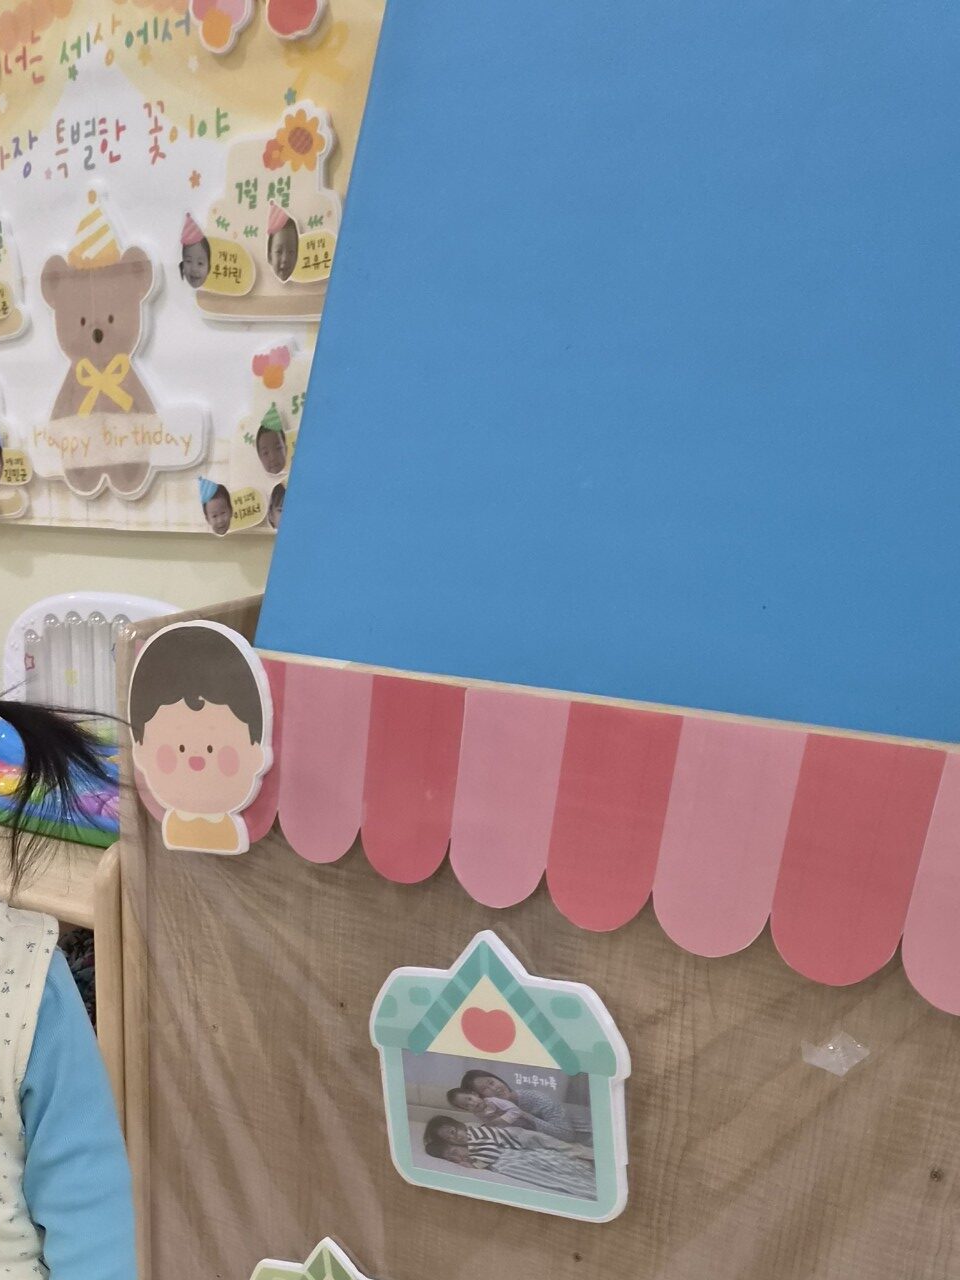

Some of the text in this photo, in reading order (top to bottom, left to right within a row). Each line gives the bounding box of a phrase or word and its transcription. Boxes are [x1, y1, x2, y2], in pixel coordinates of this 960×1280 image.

[3, 9, 190, 85] 너는 세상 에서
[54, 116, 127, 179] 특별한
[142, 100, 231, 166] 꽃이야
[211, 263, 243, 285] 우하린
[301, 250, 332, 271] 고유은
[32, 421, 193, 458] Happy birthday
